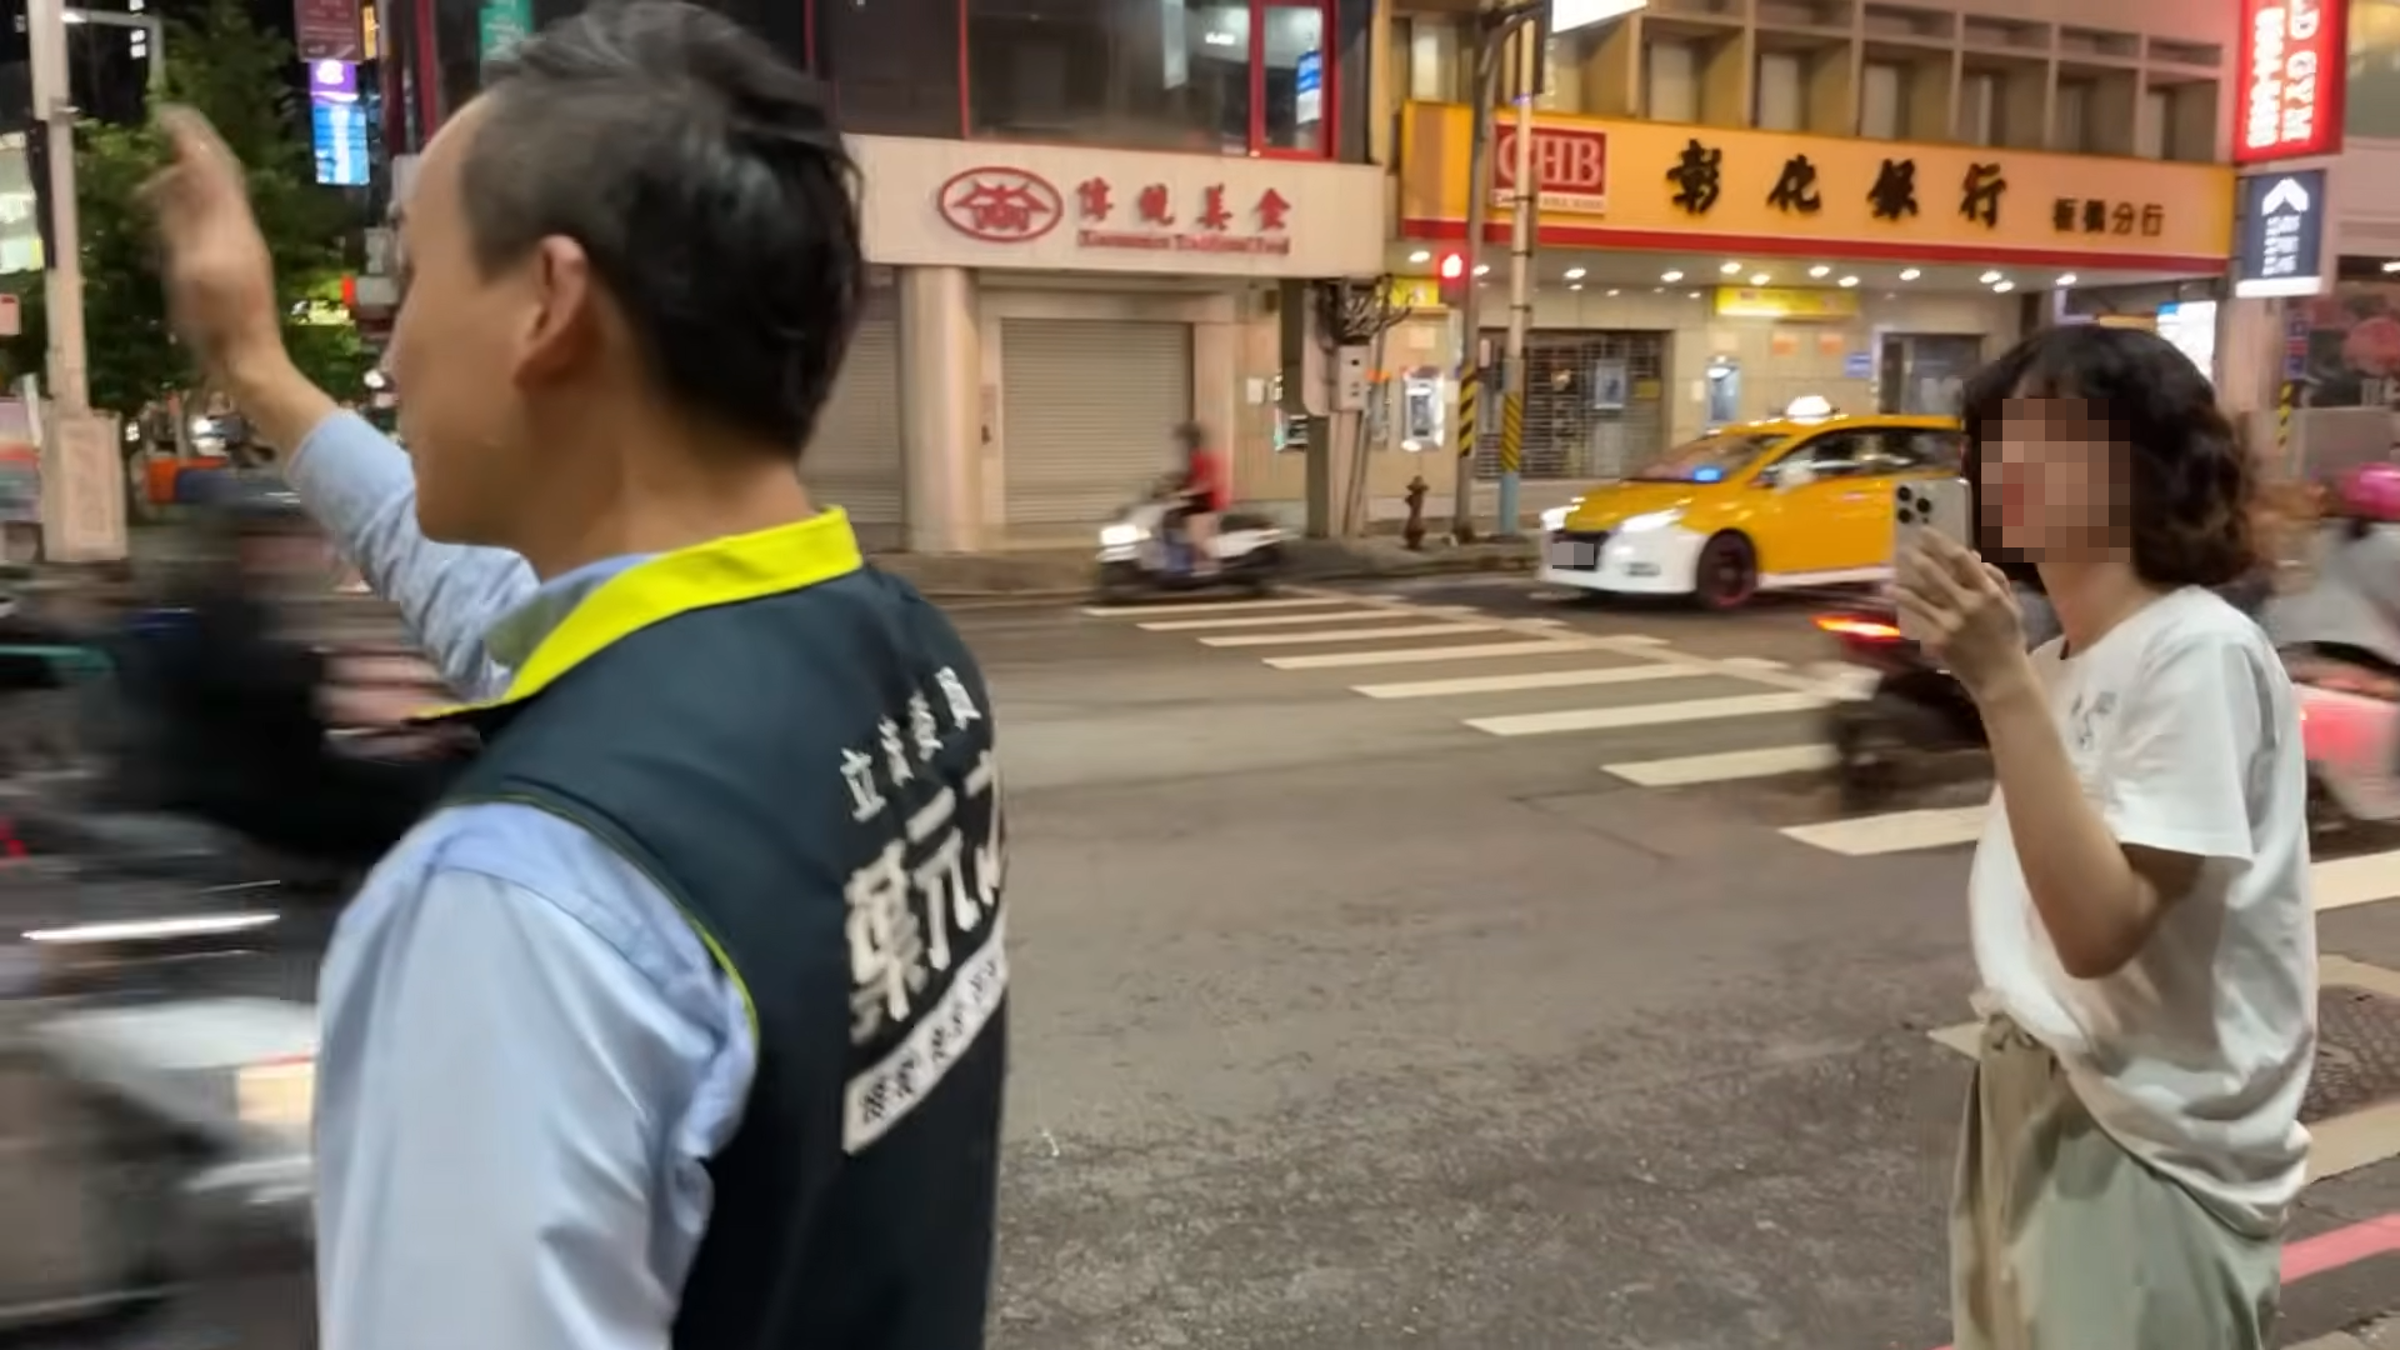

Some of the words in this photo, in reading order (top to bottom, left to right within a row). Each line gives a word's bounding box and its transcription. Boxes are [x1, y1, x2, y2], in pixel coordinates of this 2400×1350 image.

[2284, 50, 2317, 142] GYM
[1498, 132, 1601, 187] CHB
[1666, 138, 2007, 228] 彰化銀行
